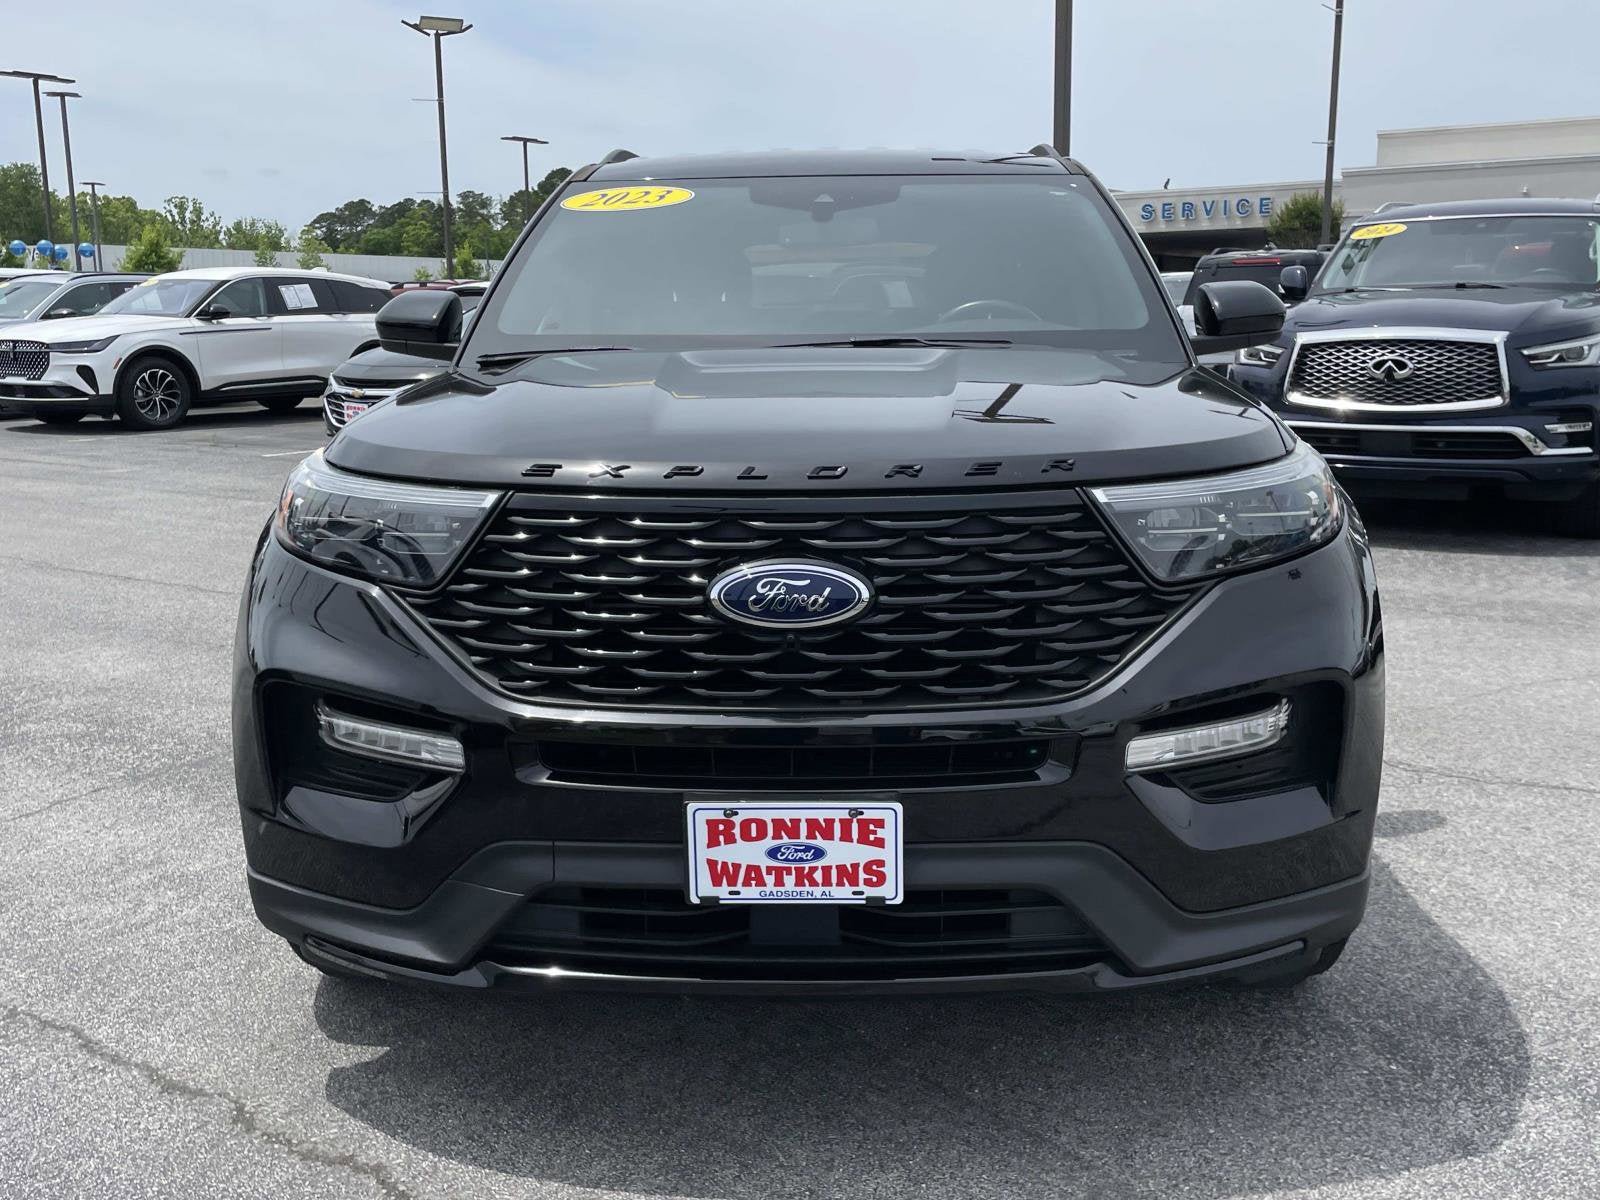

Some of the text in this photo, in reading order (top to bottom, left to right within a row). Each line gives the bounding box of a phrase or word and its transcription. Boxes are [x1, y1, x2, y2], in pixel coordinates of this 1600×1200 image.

[578, 190, 673, 208] 2023
[1141, 197, 1273, 221] SERVICE
[520, 458, 1076, 480] EXPLORER
[748, 577, 832, 613] Ford
[705, 817, 886, 849] RONNIE
[776, 845, 815, 861] Ford
[706, 857, 887, 888] WATKINS
[759, 889, 835, 899] GADSDEN, AL
